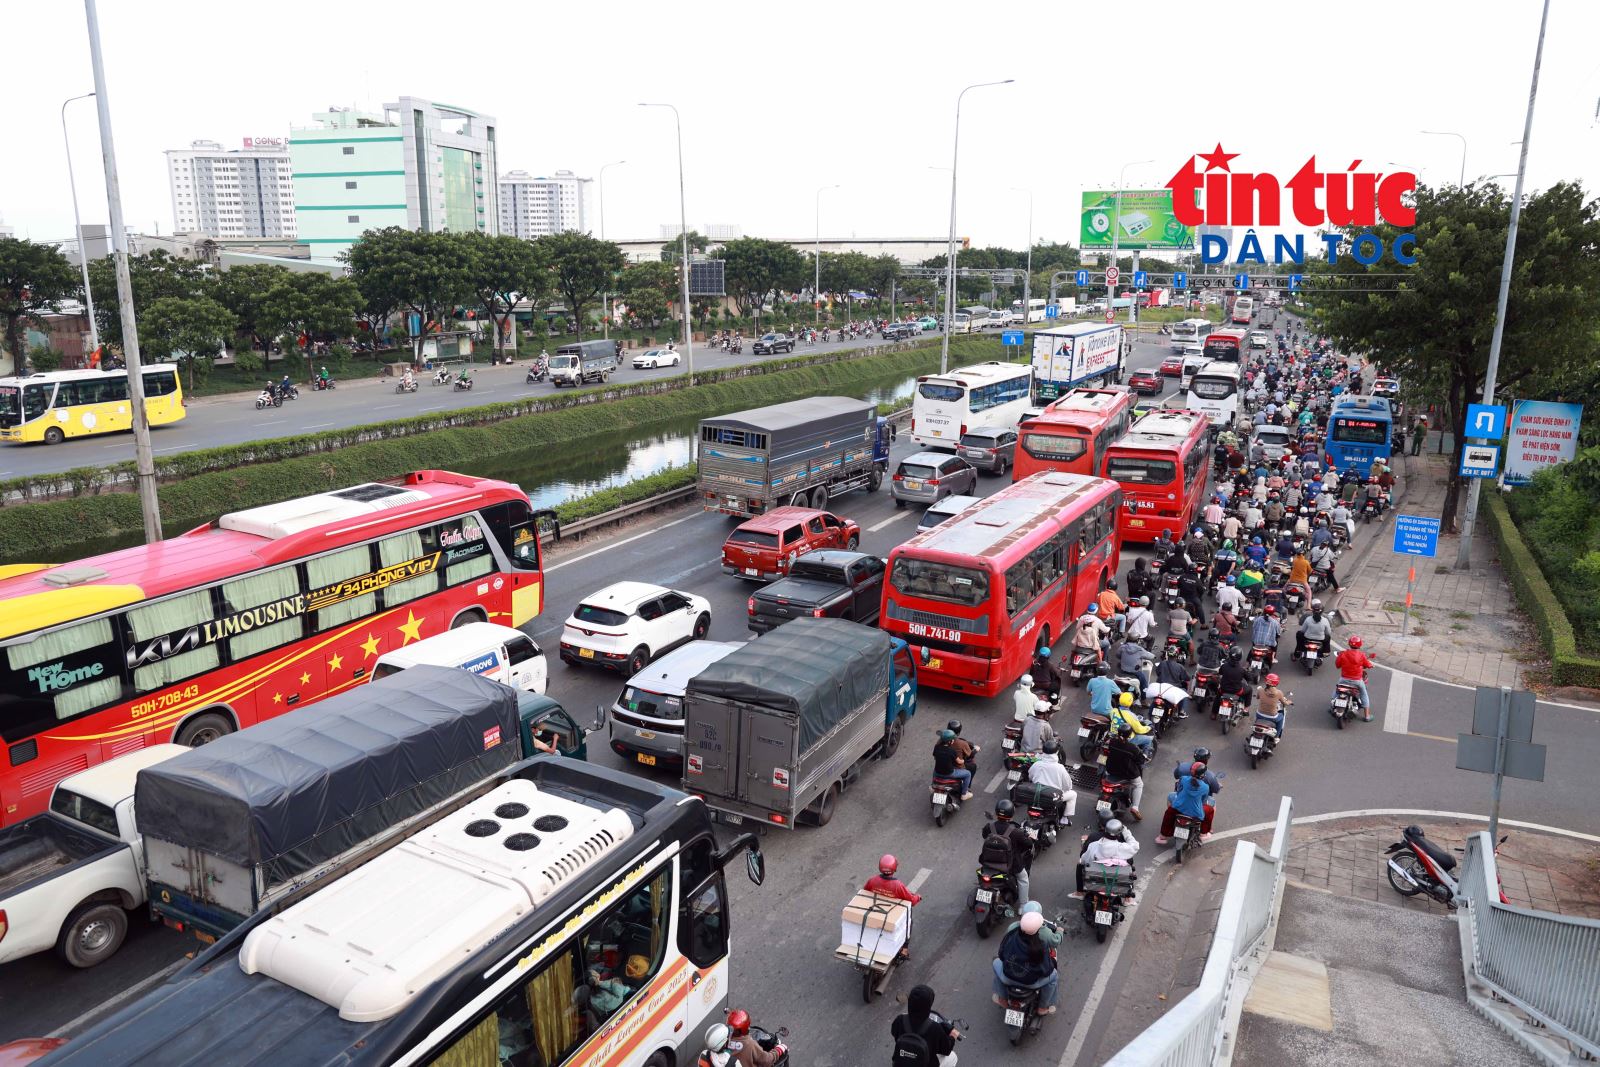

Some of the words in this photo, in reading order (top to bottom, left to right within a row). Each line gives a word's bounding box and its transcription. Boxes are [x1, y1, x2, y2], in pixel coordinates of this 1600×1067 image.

[1086, 352, 1105, 368] EXPRESS
[407, 558, 432, 575] VIP
[203, 594, 307, 645] LIMOUSINE
[28, 661, 64, 682] New
[39, 662, 104, 693] Home
